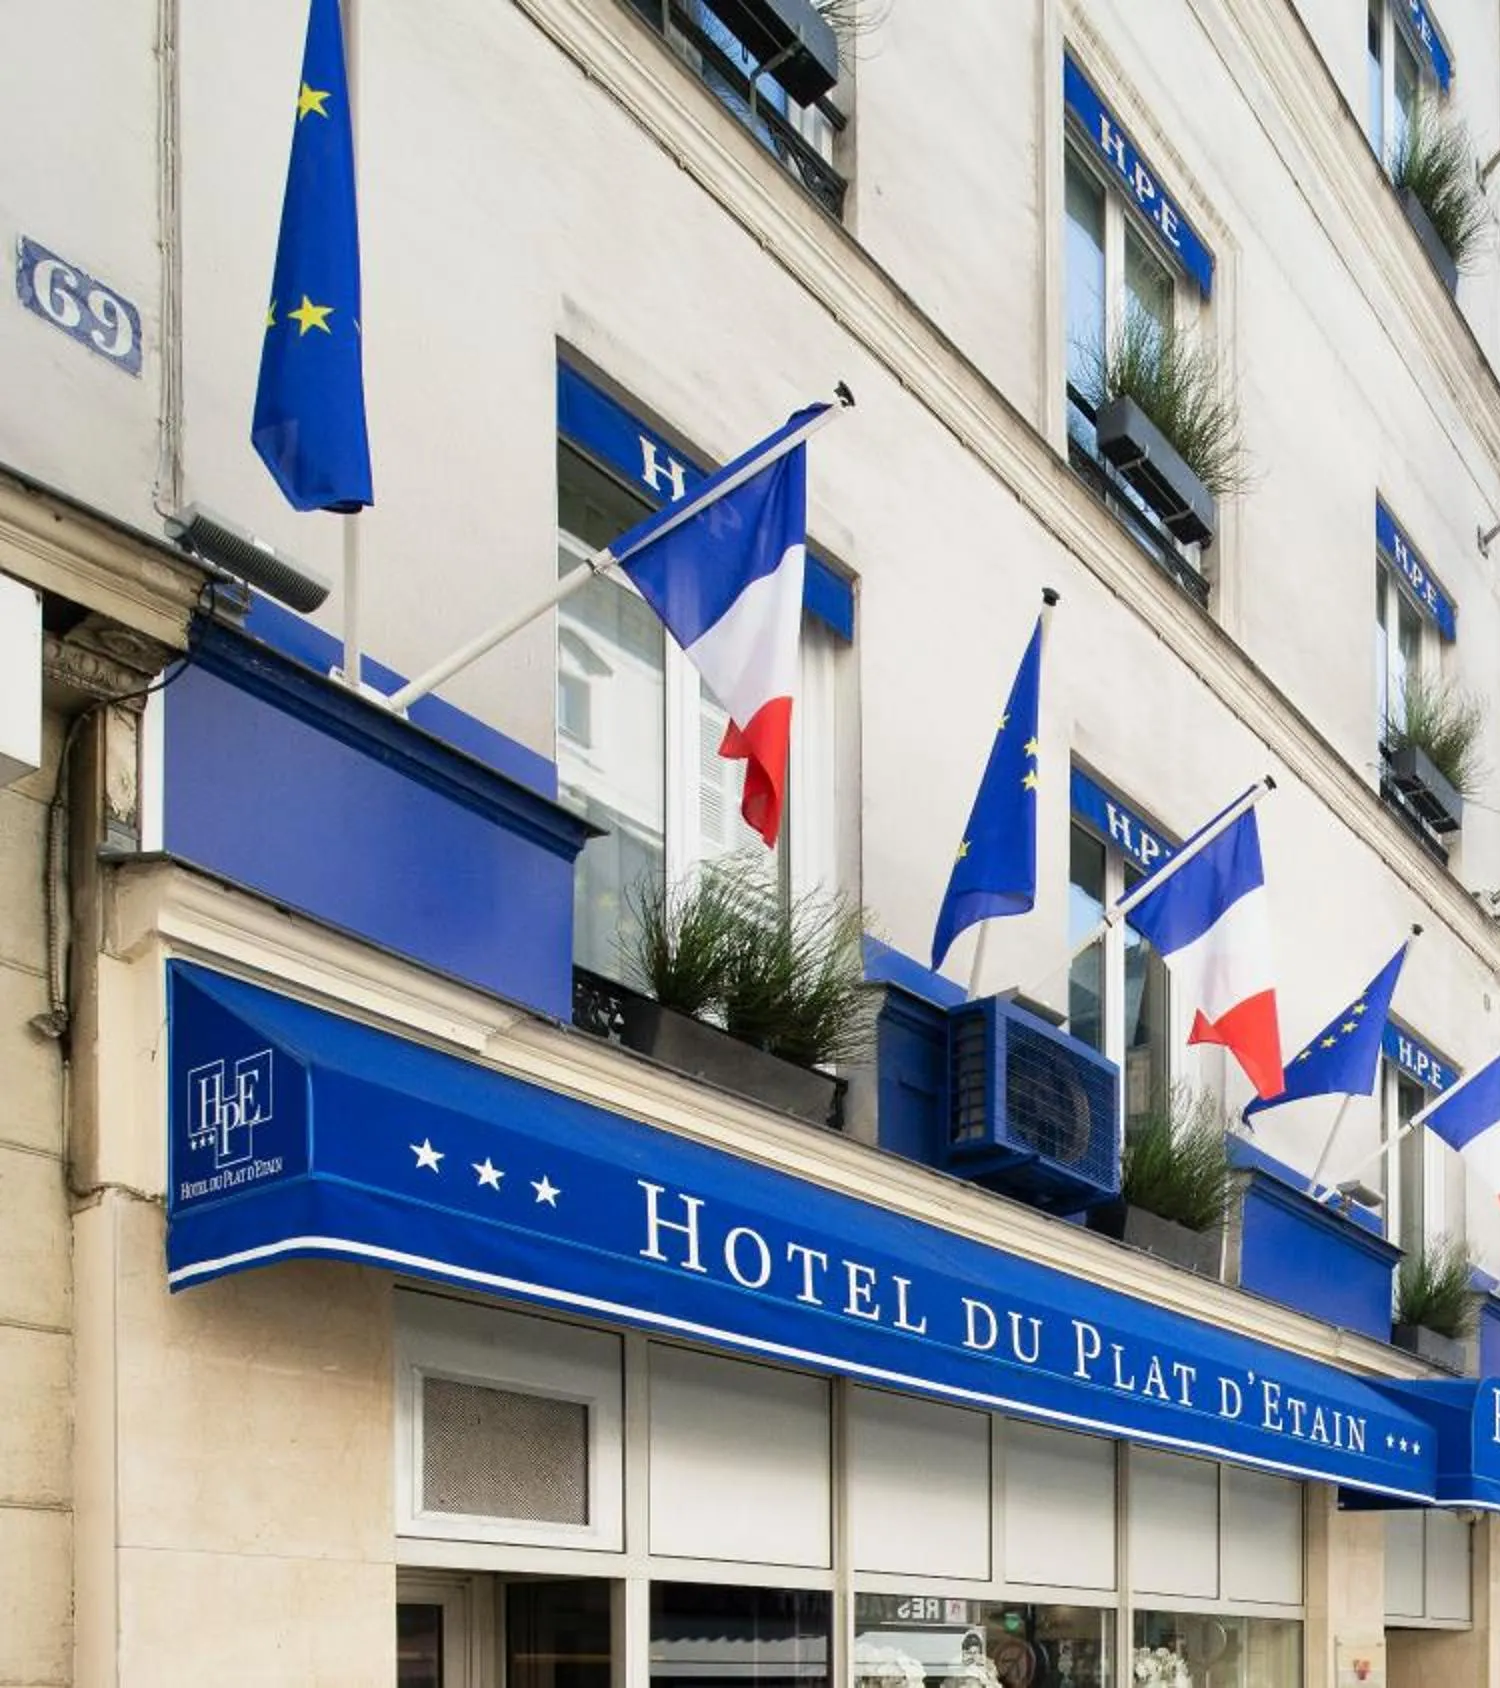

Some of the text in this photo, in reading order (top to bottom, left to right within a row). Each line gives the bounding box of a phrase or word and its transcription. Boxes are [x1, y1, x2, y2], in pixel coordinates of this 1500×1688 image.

[33, 259, 133, 357] 69
[638, 1180, 1367, 1453] HOTEL DU PLAT D'ETAIN
